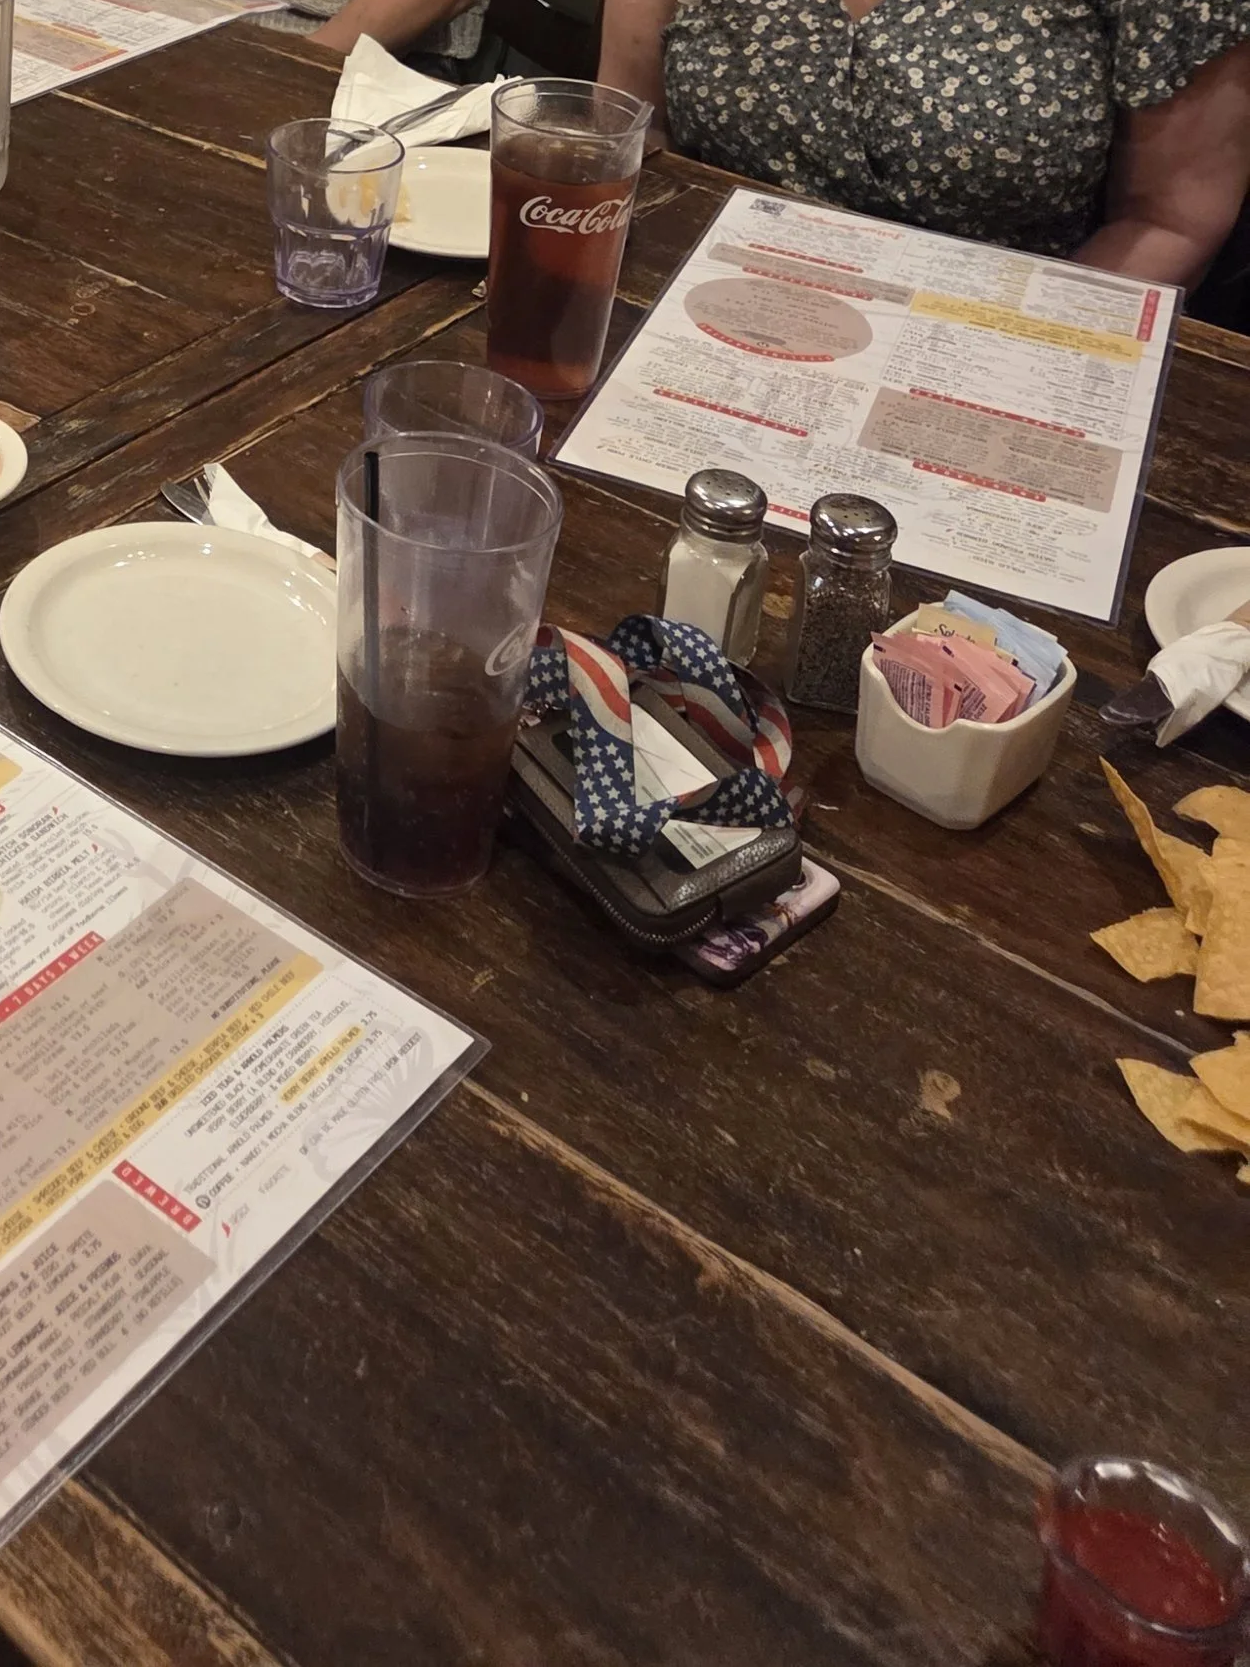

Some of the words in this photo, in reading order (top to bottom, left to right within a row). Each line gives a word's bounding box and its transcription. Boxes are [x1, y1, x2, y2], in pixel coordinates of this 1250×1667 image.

[20, 967, 58, 996] DAYS
[66, 932, 104, 961] WEEK
[118, 1164, 196, 1226] BREWED
